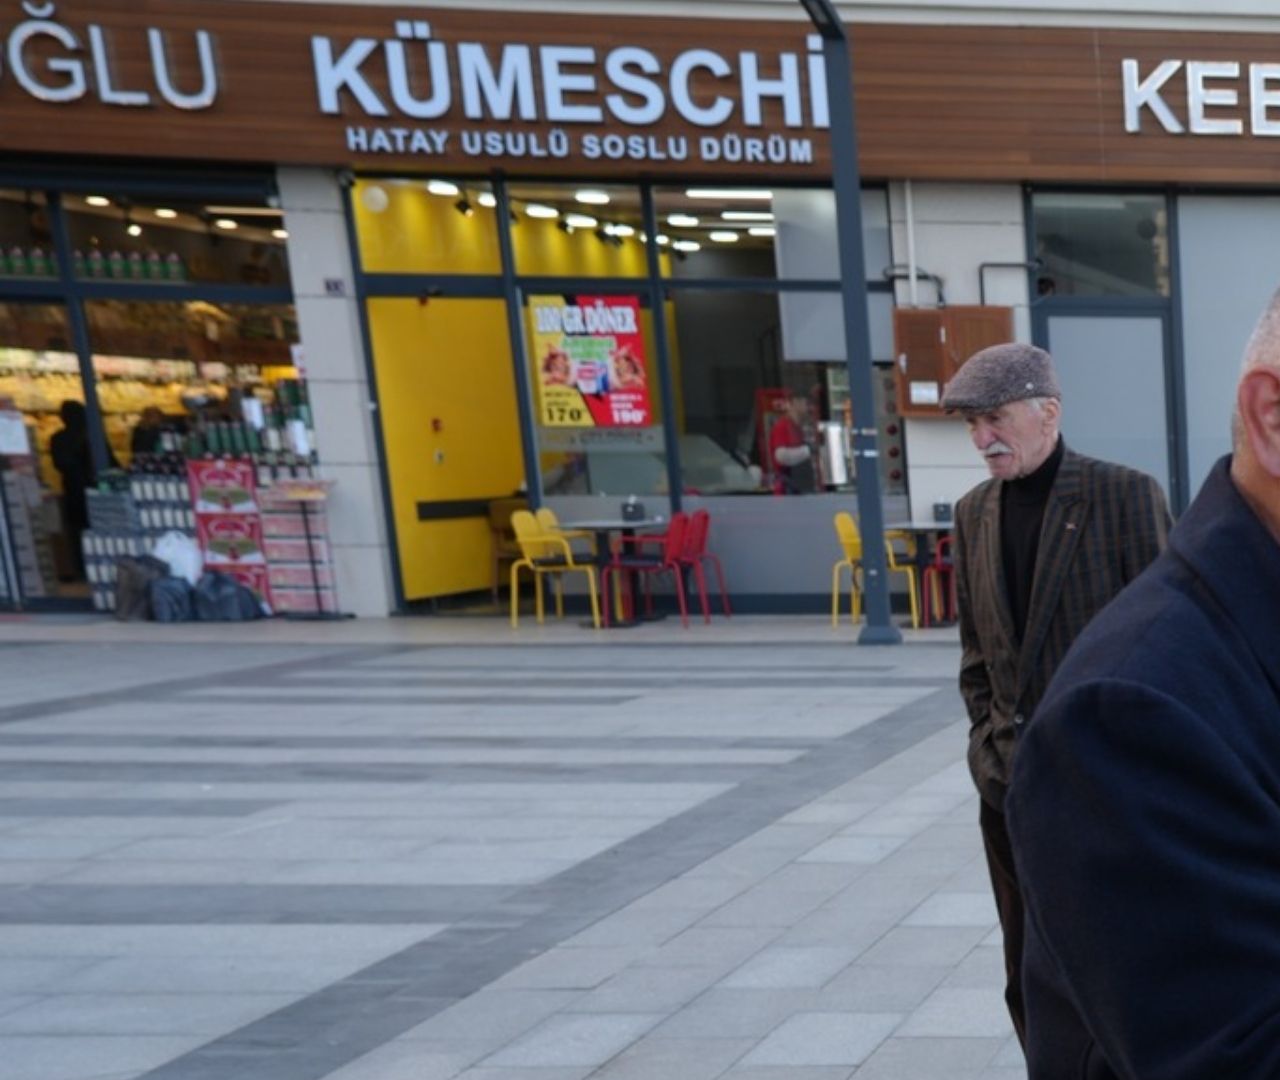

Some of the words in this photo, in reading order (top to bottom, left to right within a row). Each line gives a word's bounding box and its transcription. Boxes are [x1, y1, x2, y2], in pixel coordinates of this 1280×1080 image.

[0, 0, 218, 110] ĞLU
[311, 20, 831, 128] KÜMESCHİ
[346, 127, 448, 153] HATAY
[462, 129, 569, 157] USULÜ
[582, 134, 687, 160] SOSLU
[702, 134, 813, 163] DÜRÜM
[584, 299, 639, 334] DÖNER
[545, 408, 581, 422] 170
